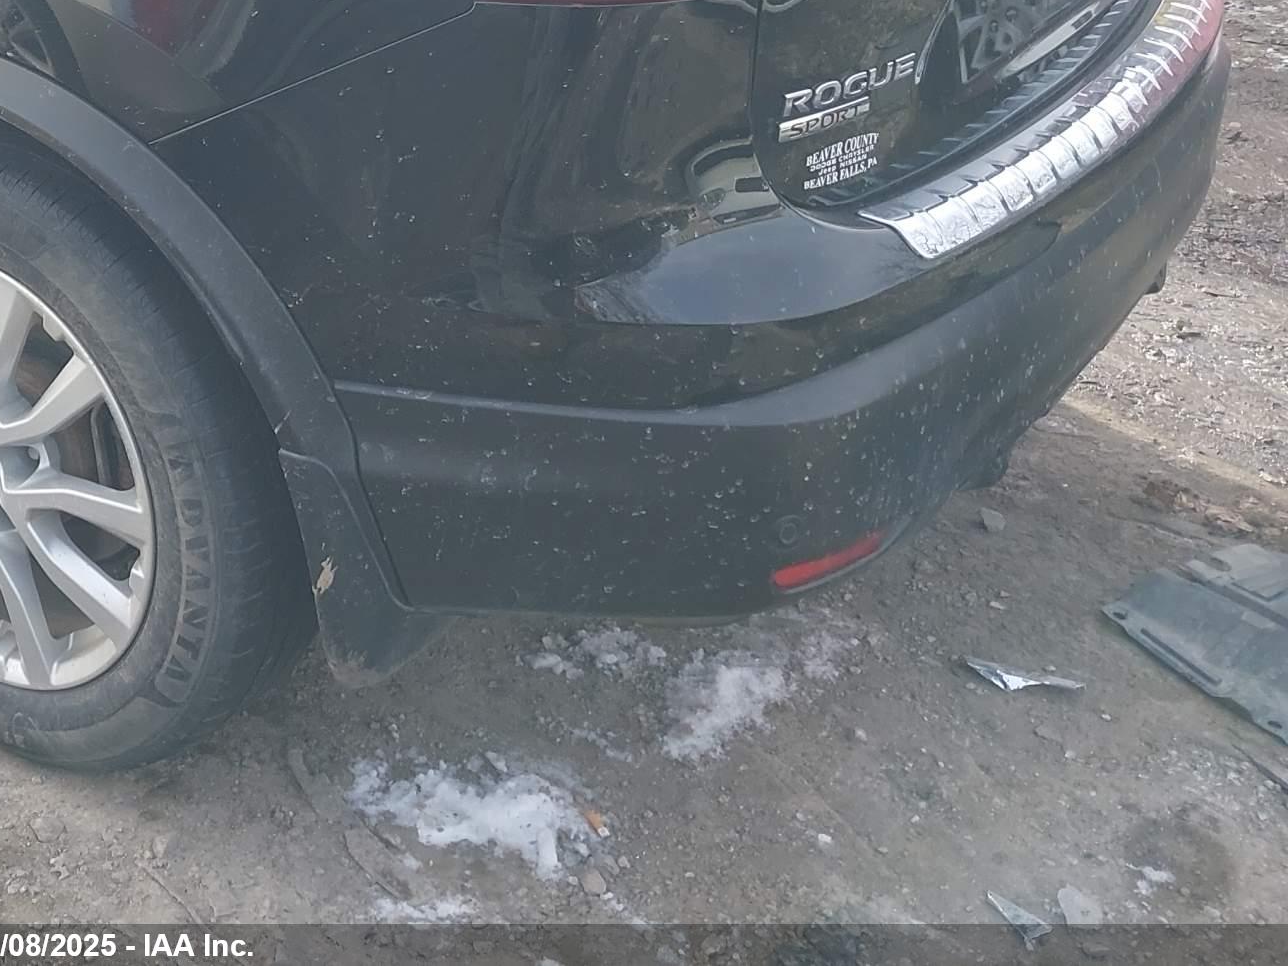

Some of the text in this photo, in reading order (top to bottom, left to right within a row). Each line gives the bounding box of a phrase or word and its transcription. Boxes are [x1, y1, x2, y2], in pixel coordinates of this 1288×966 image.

[783, 52, 916, 117] ROGUE
[806, 132, 880, 166] BEAVER COUNTY
[839, 154, 868, 168] NISSAN
[803, 172, 838, 190] BEAVER
[867, 156, 878, 169] PA
